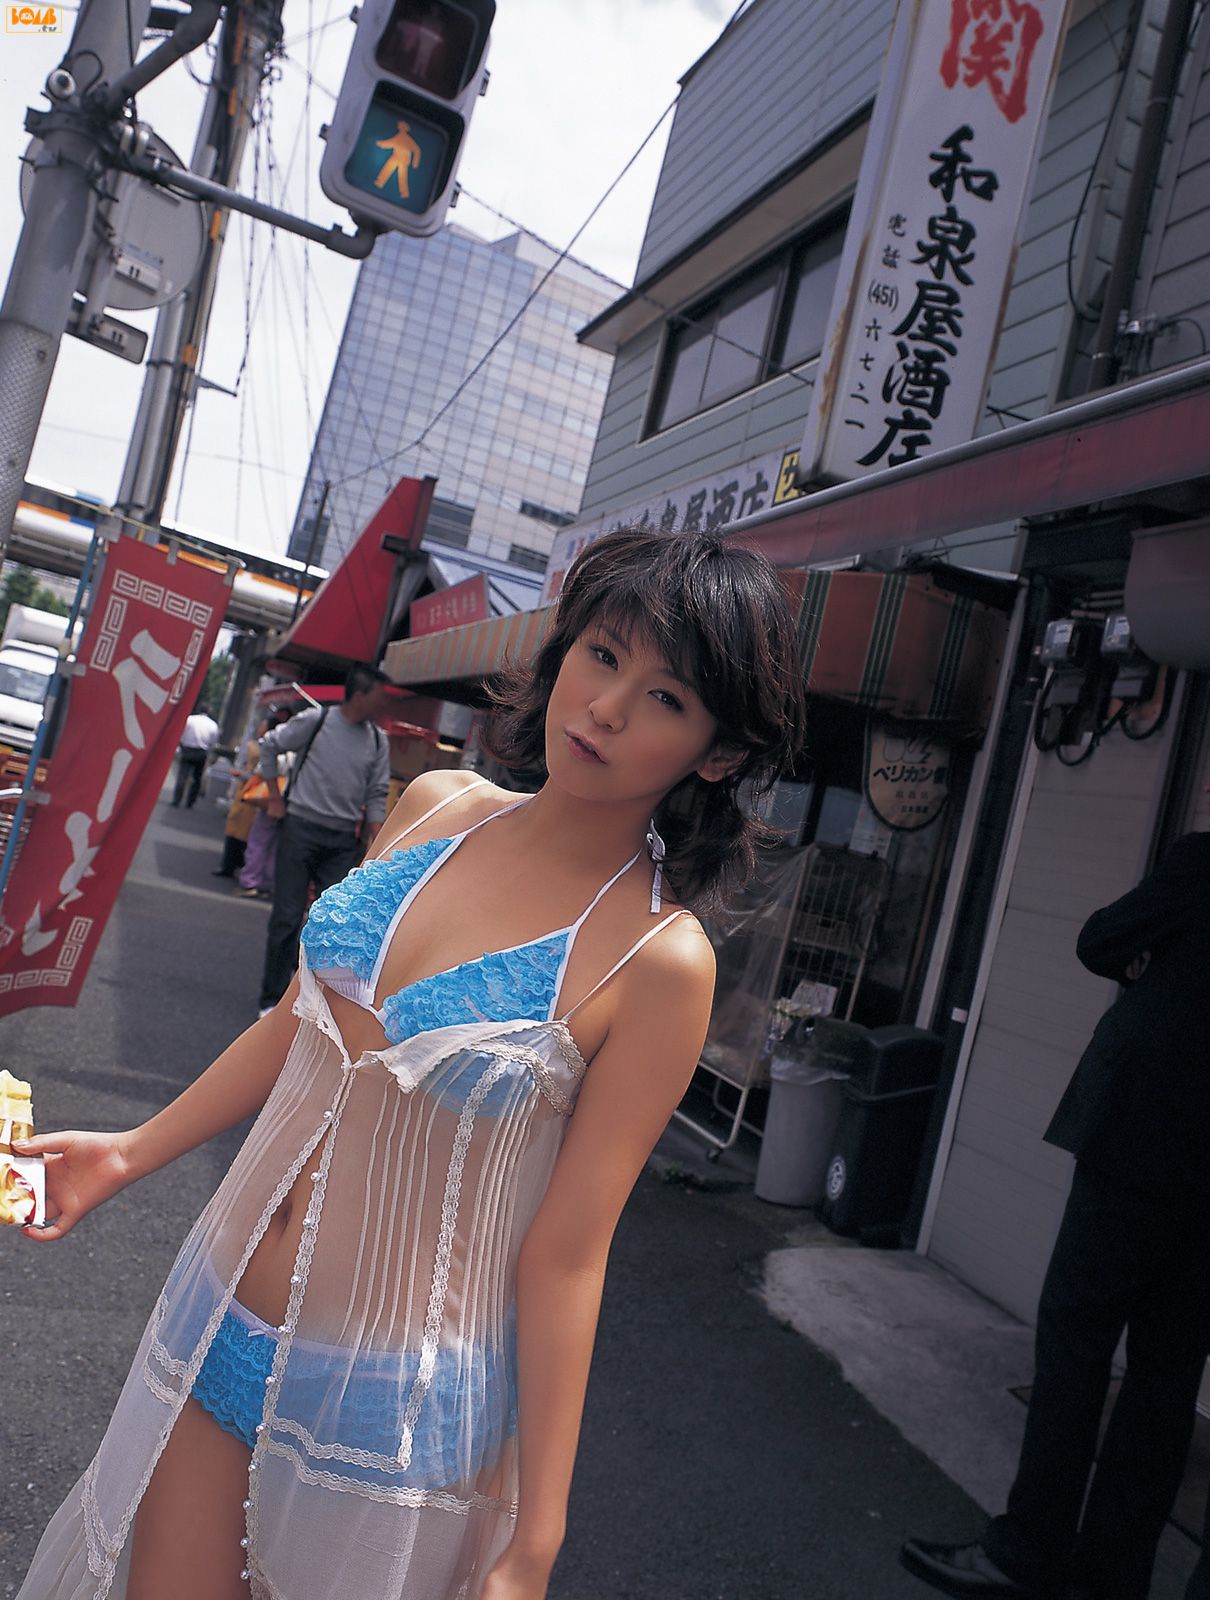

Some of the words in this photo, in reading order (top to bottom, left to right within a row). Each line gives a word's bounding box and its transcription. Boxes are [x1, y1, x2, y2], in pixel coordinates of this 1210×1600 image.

[857, 125, 998, 467] 和泉屋酒店
